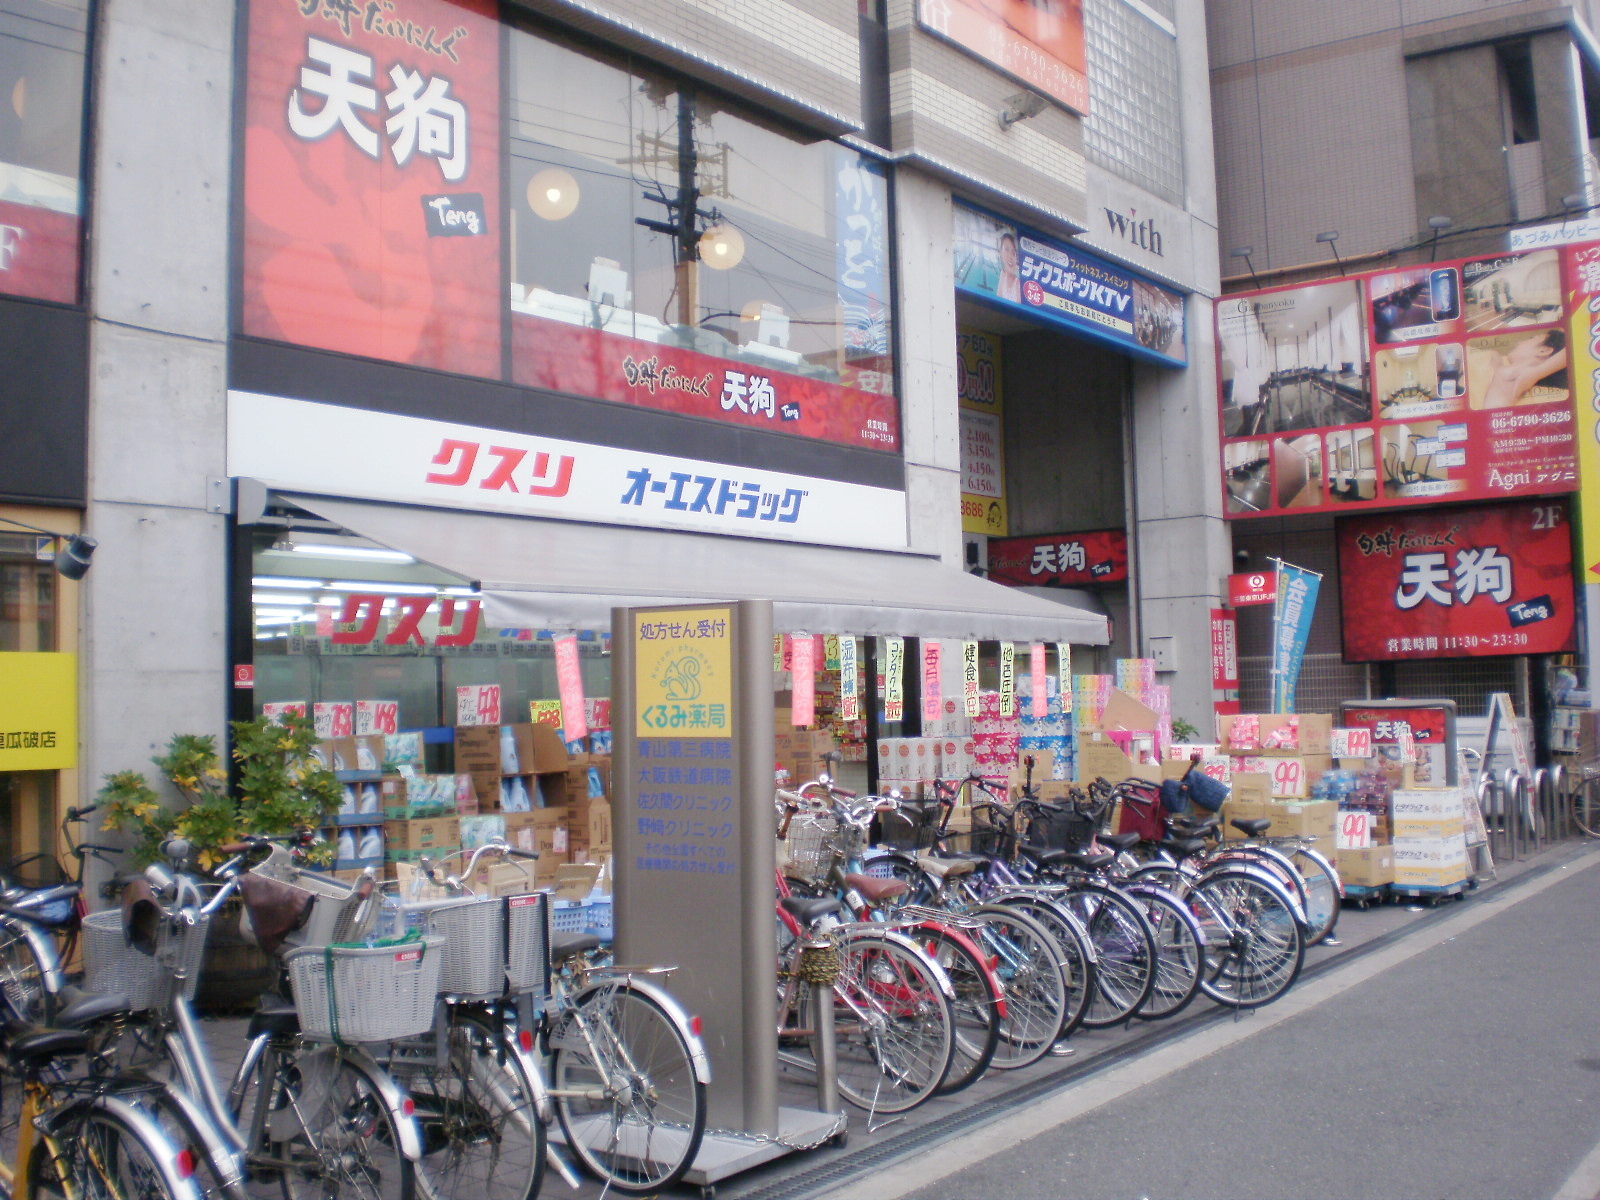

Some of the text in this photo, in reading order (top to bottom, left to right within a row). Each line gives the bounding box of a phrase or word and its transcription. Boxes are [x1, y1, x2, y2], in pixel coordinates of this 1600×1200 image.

[288, 37, 469, 180] 天狗
[430, 197, 480, 234] Teng
[1104, 207, 1164, 258] with
[1021, 256, 1131, 312] ライフスポーツKTV
[720, 370, 775, 419] 天狗
[1492, 411, 1571, 429] 06-6790-3626
[425, 438, 576, 498] クスリ
[1488, 469, 1576, 490] Agni アグニ
[620, 467, 808, 523] オーエスドラッグ
[1532, 506, 1562, 530] 2F
[1030, 541, 1086, 575] 天狗
[1396, 547, 1513, 609] 天狗
[331, 594, 482, 647] クスリ
[640, 619, 726, 640] 処方せん受付
[1387, 636, 1438, 653] 営業時間
[889, 642, 899, 698] コンタクト
[642, 703, 726, 729] くるみ薬局
[1374, 721, 1412, 739] 天狗
[638, 766, 732, 785] 大阪鉄道病院
[1275, 761, 1300, 795] 99
[638, 792, 732, 812] 佐久間クリニック
[1342, 813, 1367, 847] 99
